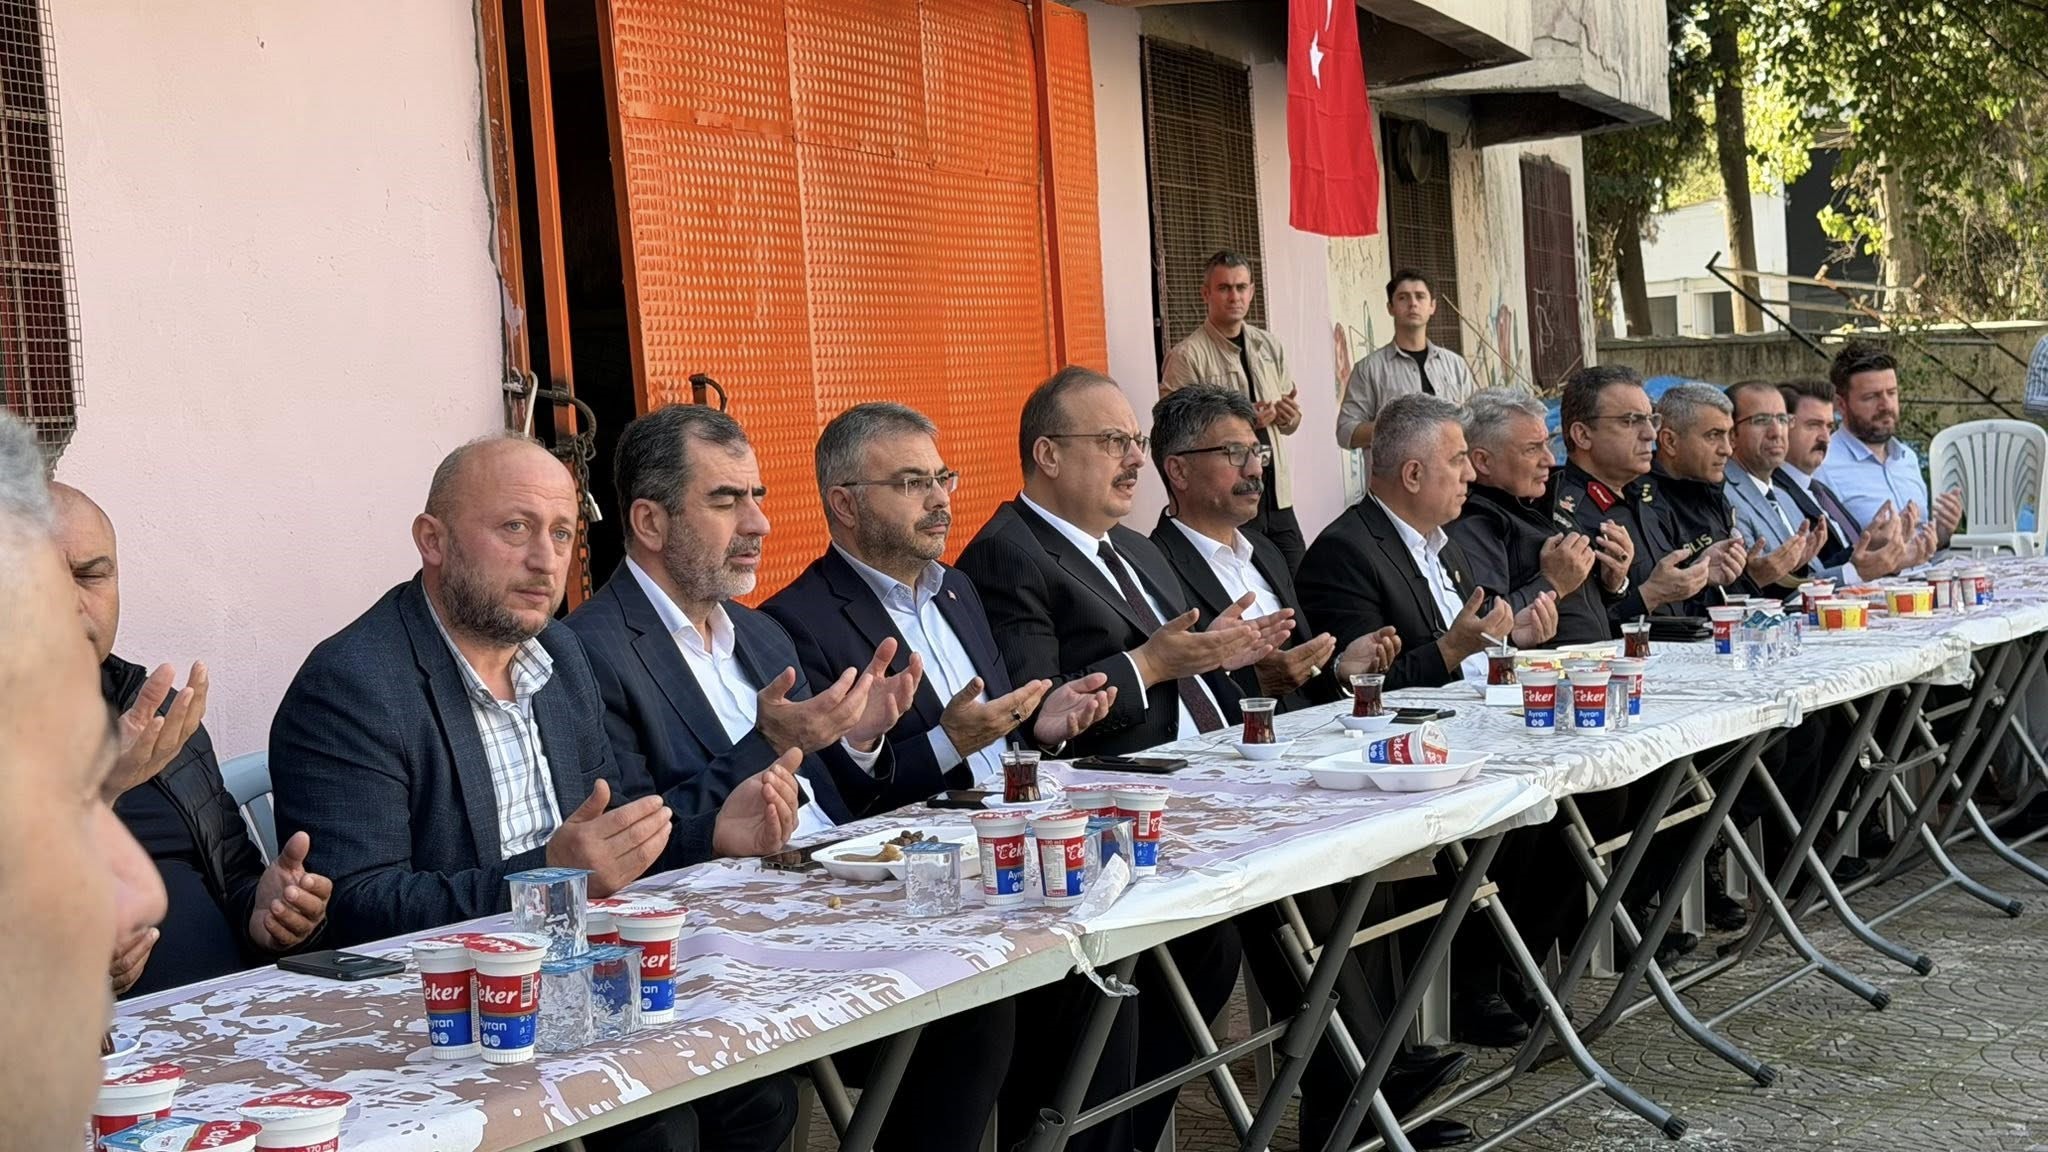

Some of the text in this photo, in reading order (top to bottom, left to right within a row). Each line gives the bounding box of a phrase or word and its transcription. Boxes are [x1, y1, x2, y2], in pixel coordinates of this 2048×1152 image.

[1683, 533, 1713, 555] OLIS
[1528, 710, 1548, 718] Ayran
[1580, 710, 1600, 718] Ayran
[640, 951, 669, 969] ker
